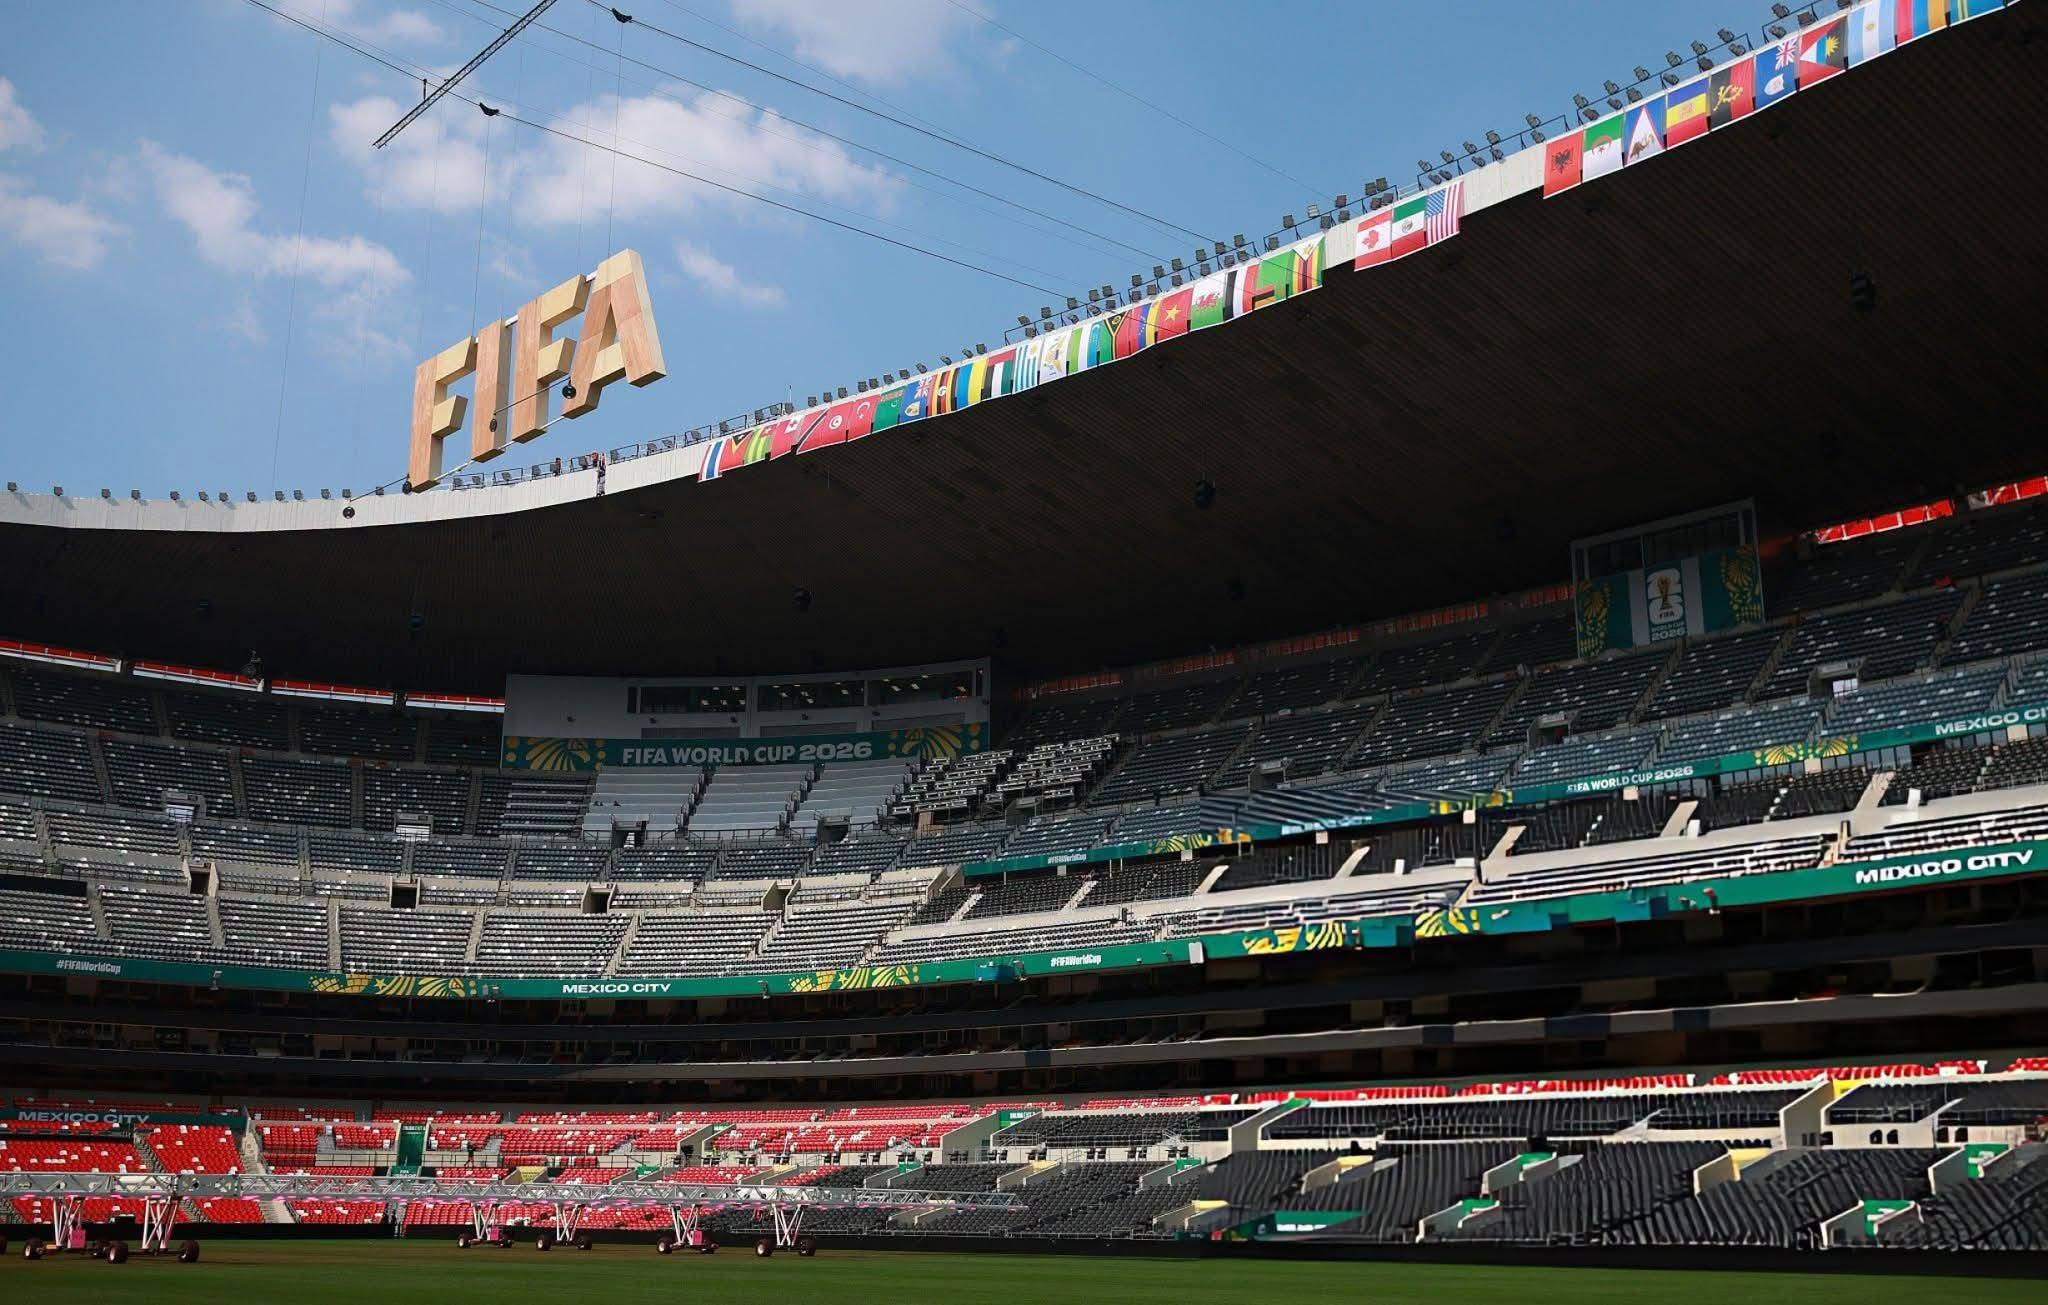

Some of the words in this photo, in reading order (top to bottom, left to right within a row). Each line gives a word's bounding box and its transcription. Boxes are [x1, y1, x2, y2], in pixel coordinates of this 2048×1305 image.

[406, 248, 667, 493] FIFA
[1652, 627, 1686, 641] 2026
[1935, 712, 2020, 735] MEXICO
[2023, 706, 2048, 720] CI
[622, 748, 668, 764] FIFA
[671, 747, 749, 764] WORLD
[754, 745, 796, 763] CUP
[799, 742, 873, 760] 2026
[1566, 781, 1590, 792] FIFA
[1591, 776, 1630, 791] WORLD
[1631, 771, 1653, 785] CUP
[1654, 765, 1694, 780] 2026
[56, 959, 121, 975] #FIFAWorldCup
[562, 983, 630, 993] MEXICO
[632, 983, 672, 993] CITY
[18, 1111, 99, 1122] MEXICO
[103, 1113, 150, 1124] CITY
